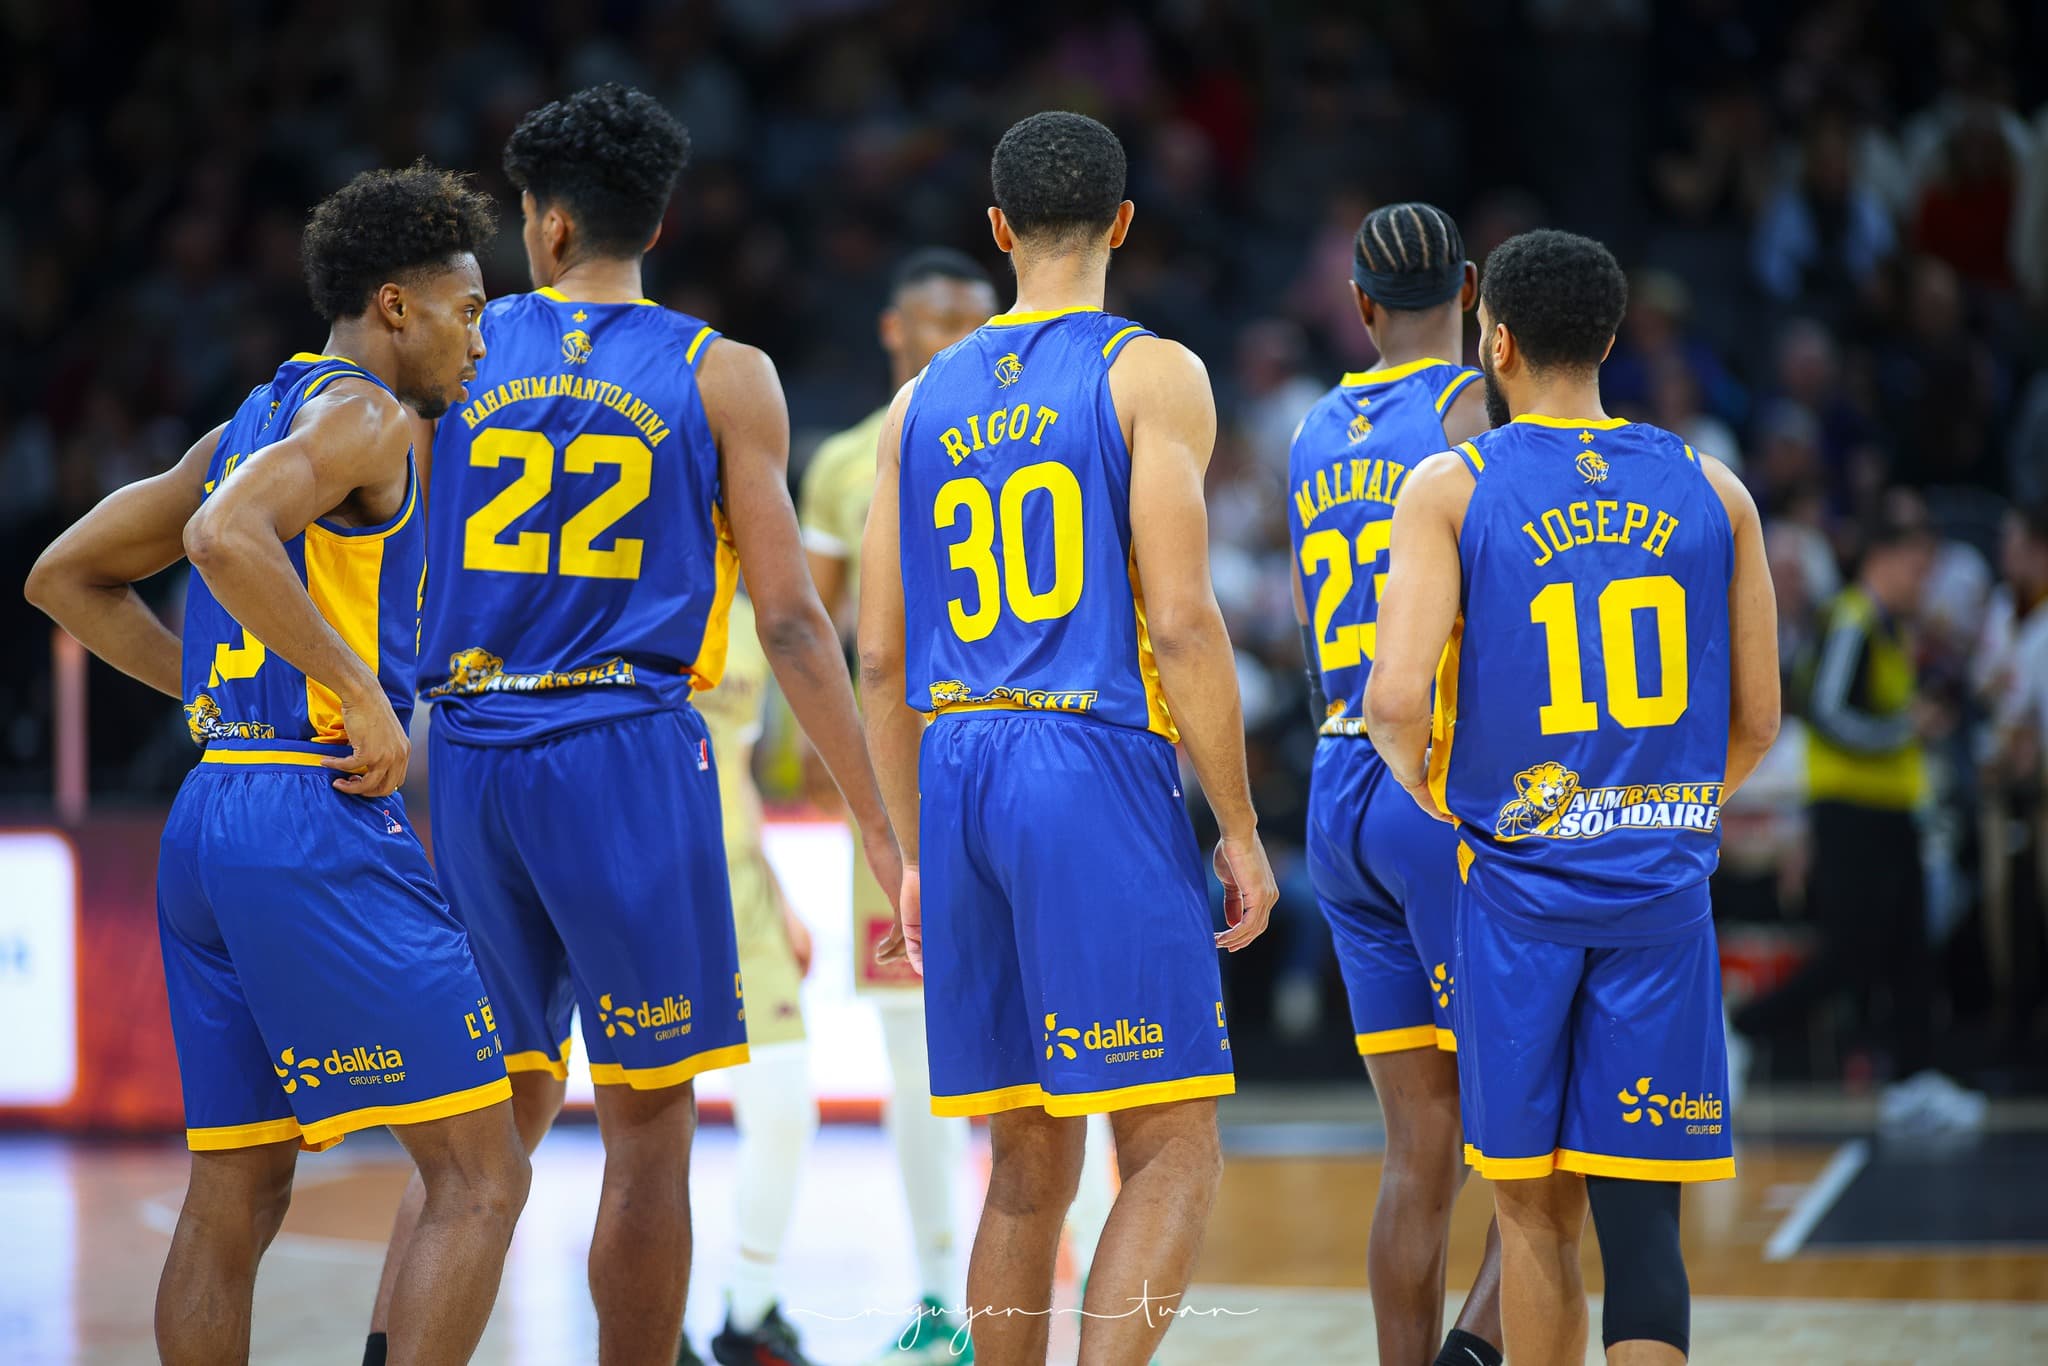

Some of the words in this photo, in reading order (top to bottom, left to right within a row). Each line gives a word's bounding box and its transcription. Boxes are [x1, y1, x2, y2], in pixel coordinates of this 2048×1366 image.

[461, 374, 672, 448] RAHARIMANANTOANINA
[939, 403, 1059, 466] RIGOT
[463, 427, 654, 580] 22
[933, 461, 1084, 643] 30
[1522, 500, 1680, 567] JOSEPH
[1529, 575, 1688, 736] 10
[1558, 802, 1720, 837] SOLIDAIRE
[637, 994, 692, 1029] dalkia
[1083, 1017, 1164, 1051] dalkia
[323, 1044, 404, 1076] dalkia
[348, 1074, 383, 1087] GROUPE
[1104, 1050, 1141, 1065] GROUPE
